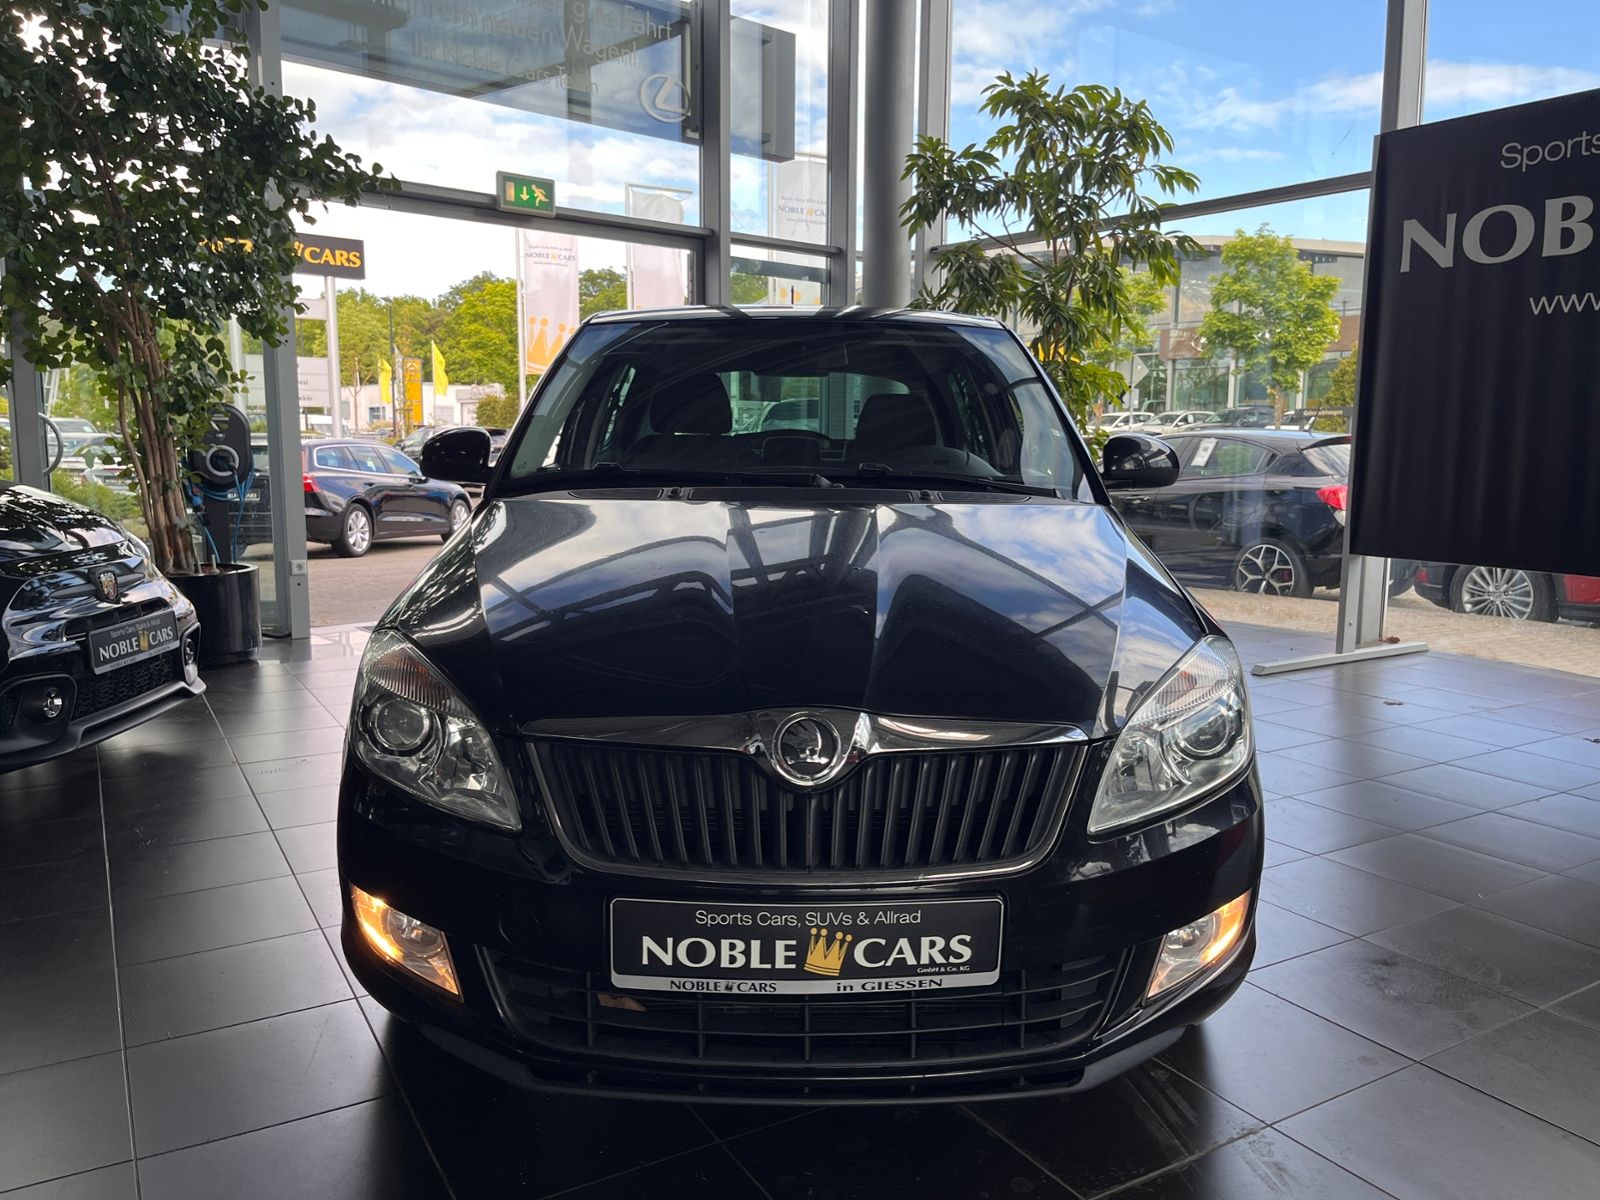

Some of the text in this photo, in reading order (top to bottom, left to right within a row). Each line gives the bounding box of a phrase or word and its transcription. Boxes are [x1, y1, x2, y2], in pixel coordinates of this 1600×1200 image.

[623, 5, 672, 40] Fahrt
[1500, 130, 1600, 173] Sports
[1400, 195, 1594, 273] NOB
[304, 246, 362, 268] CARS
[98, 637, 139, 661] NOBLE
[149, 626, 173, 645] CARS
[695, 909, 921, 929] Sports Cars, SUVs & Allrad
[641, 934, 972, 970] NOBLE CARS
[670, 978, 943, 993] NOBLE CARS in GIESSEN
[917, 966, 939, 974] GmbH
